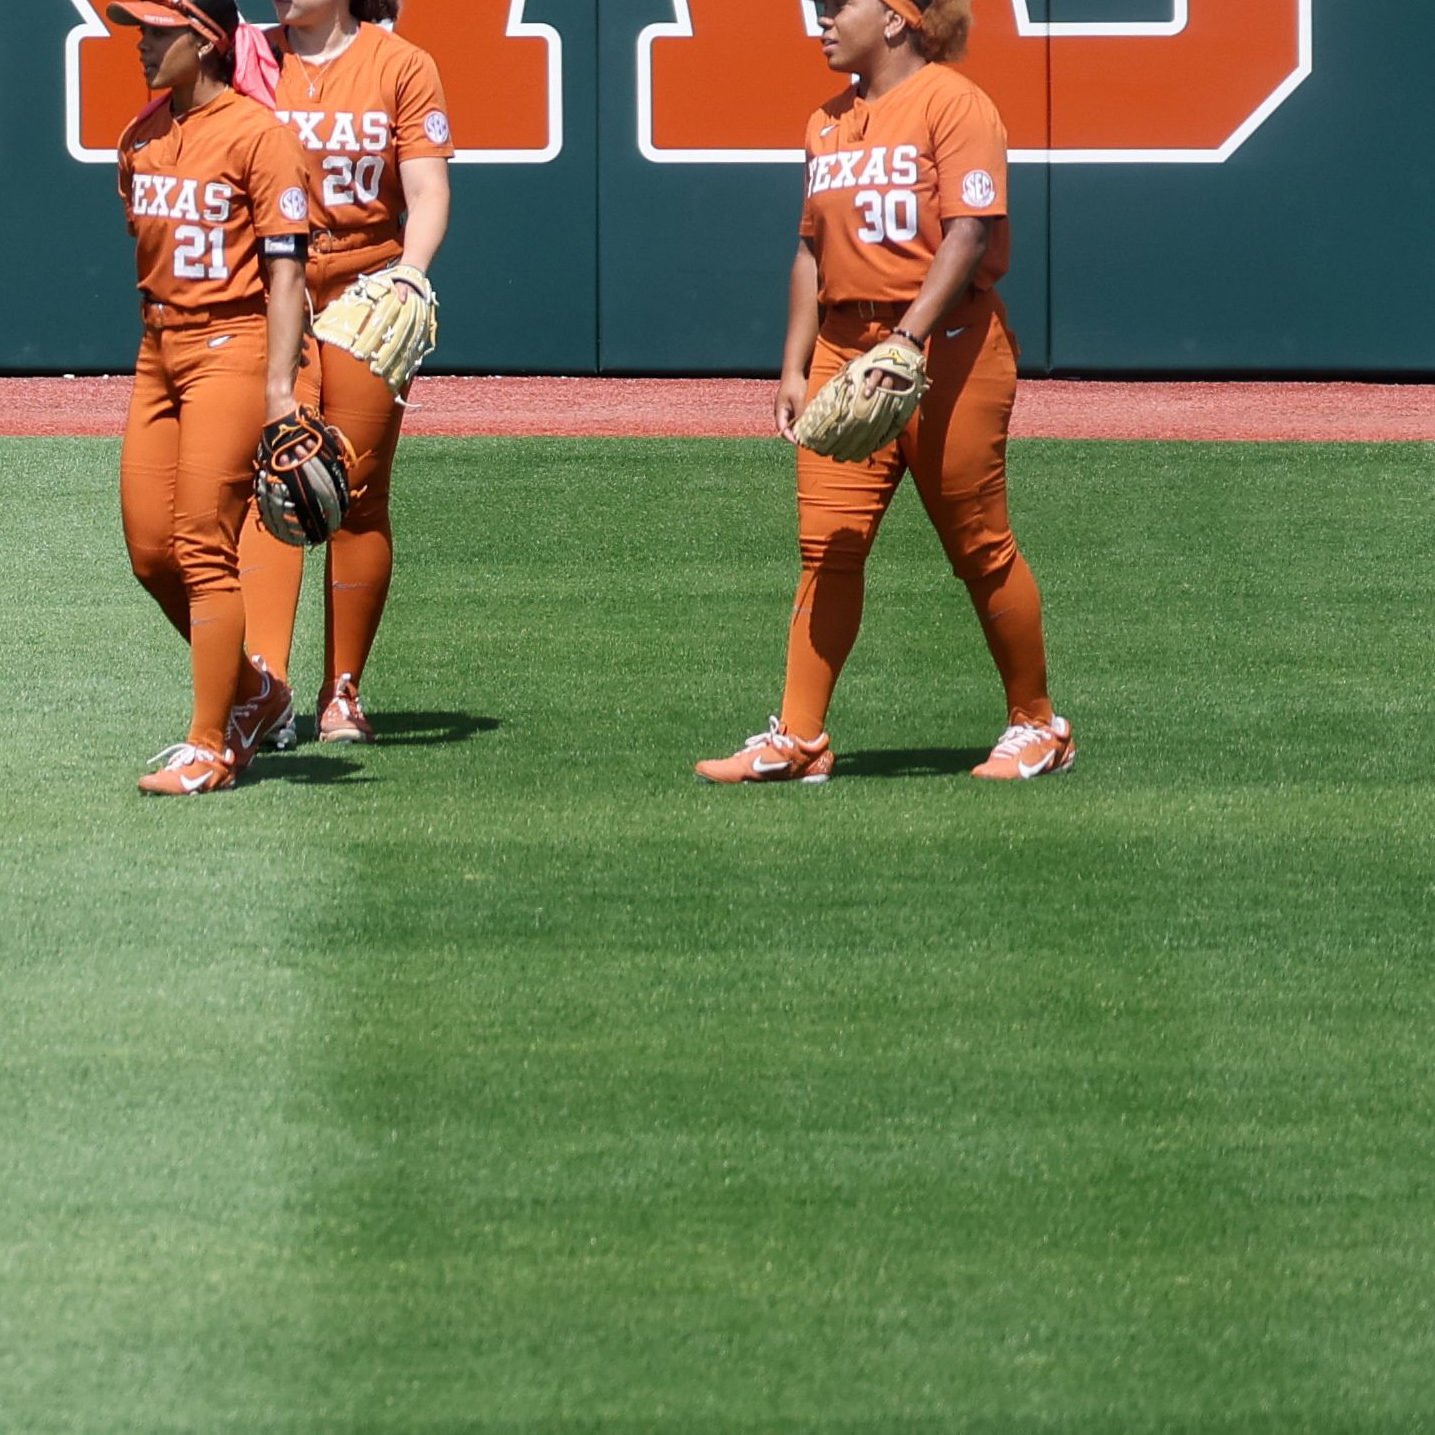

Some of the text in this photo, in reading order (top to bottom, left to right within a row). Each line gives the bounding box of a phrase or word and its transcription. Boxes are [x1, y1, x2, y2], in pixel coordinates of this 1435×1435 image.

[275, 110, 389, 152] XAS
[132, 173, 232, 222] EXAS
[322, 155, 385, 206] 20
[854, 189, 918, 244] 30
[172, 224, 229, 279] 21
